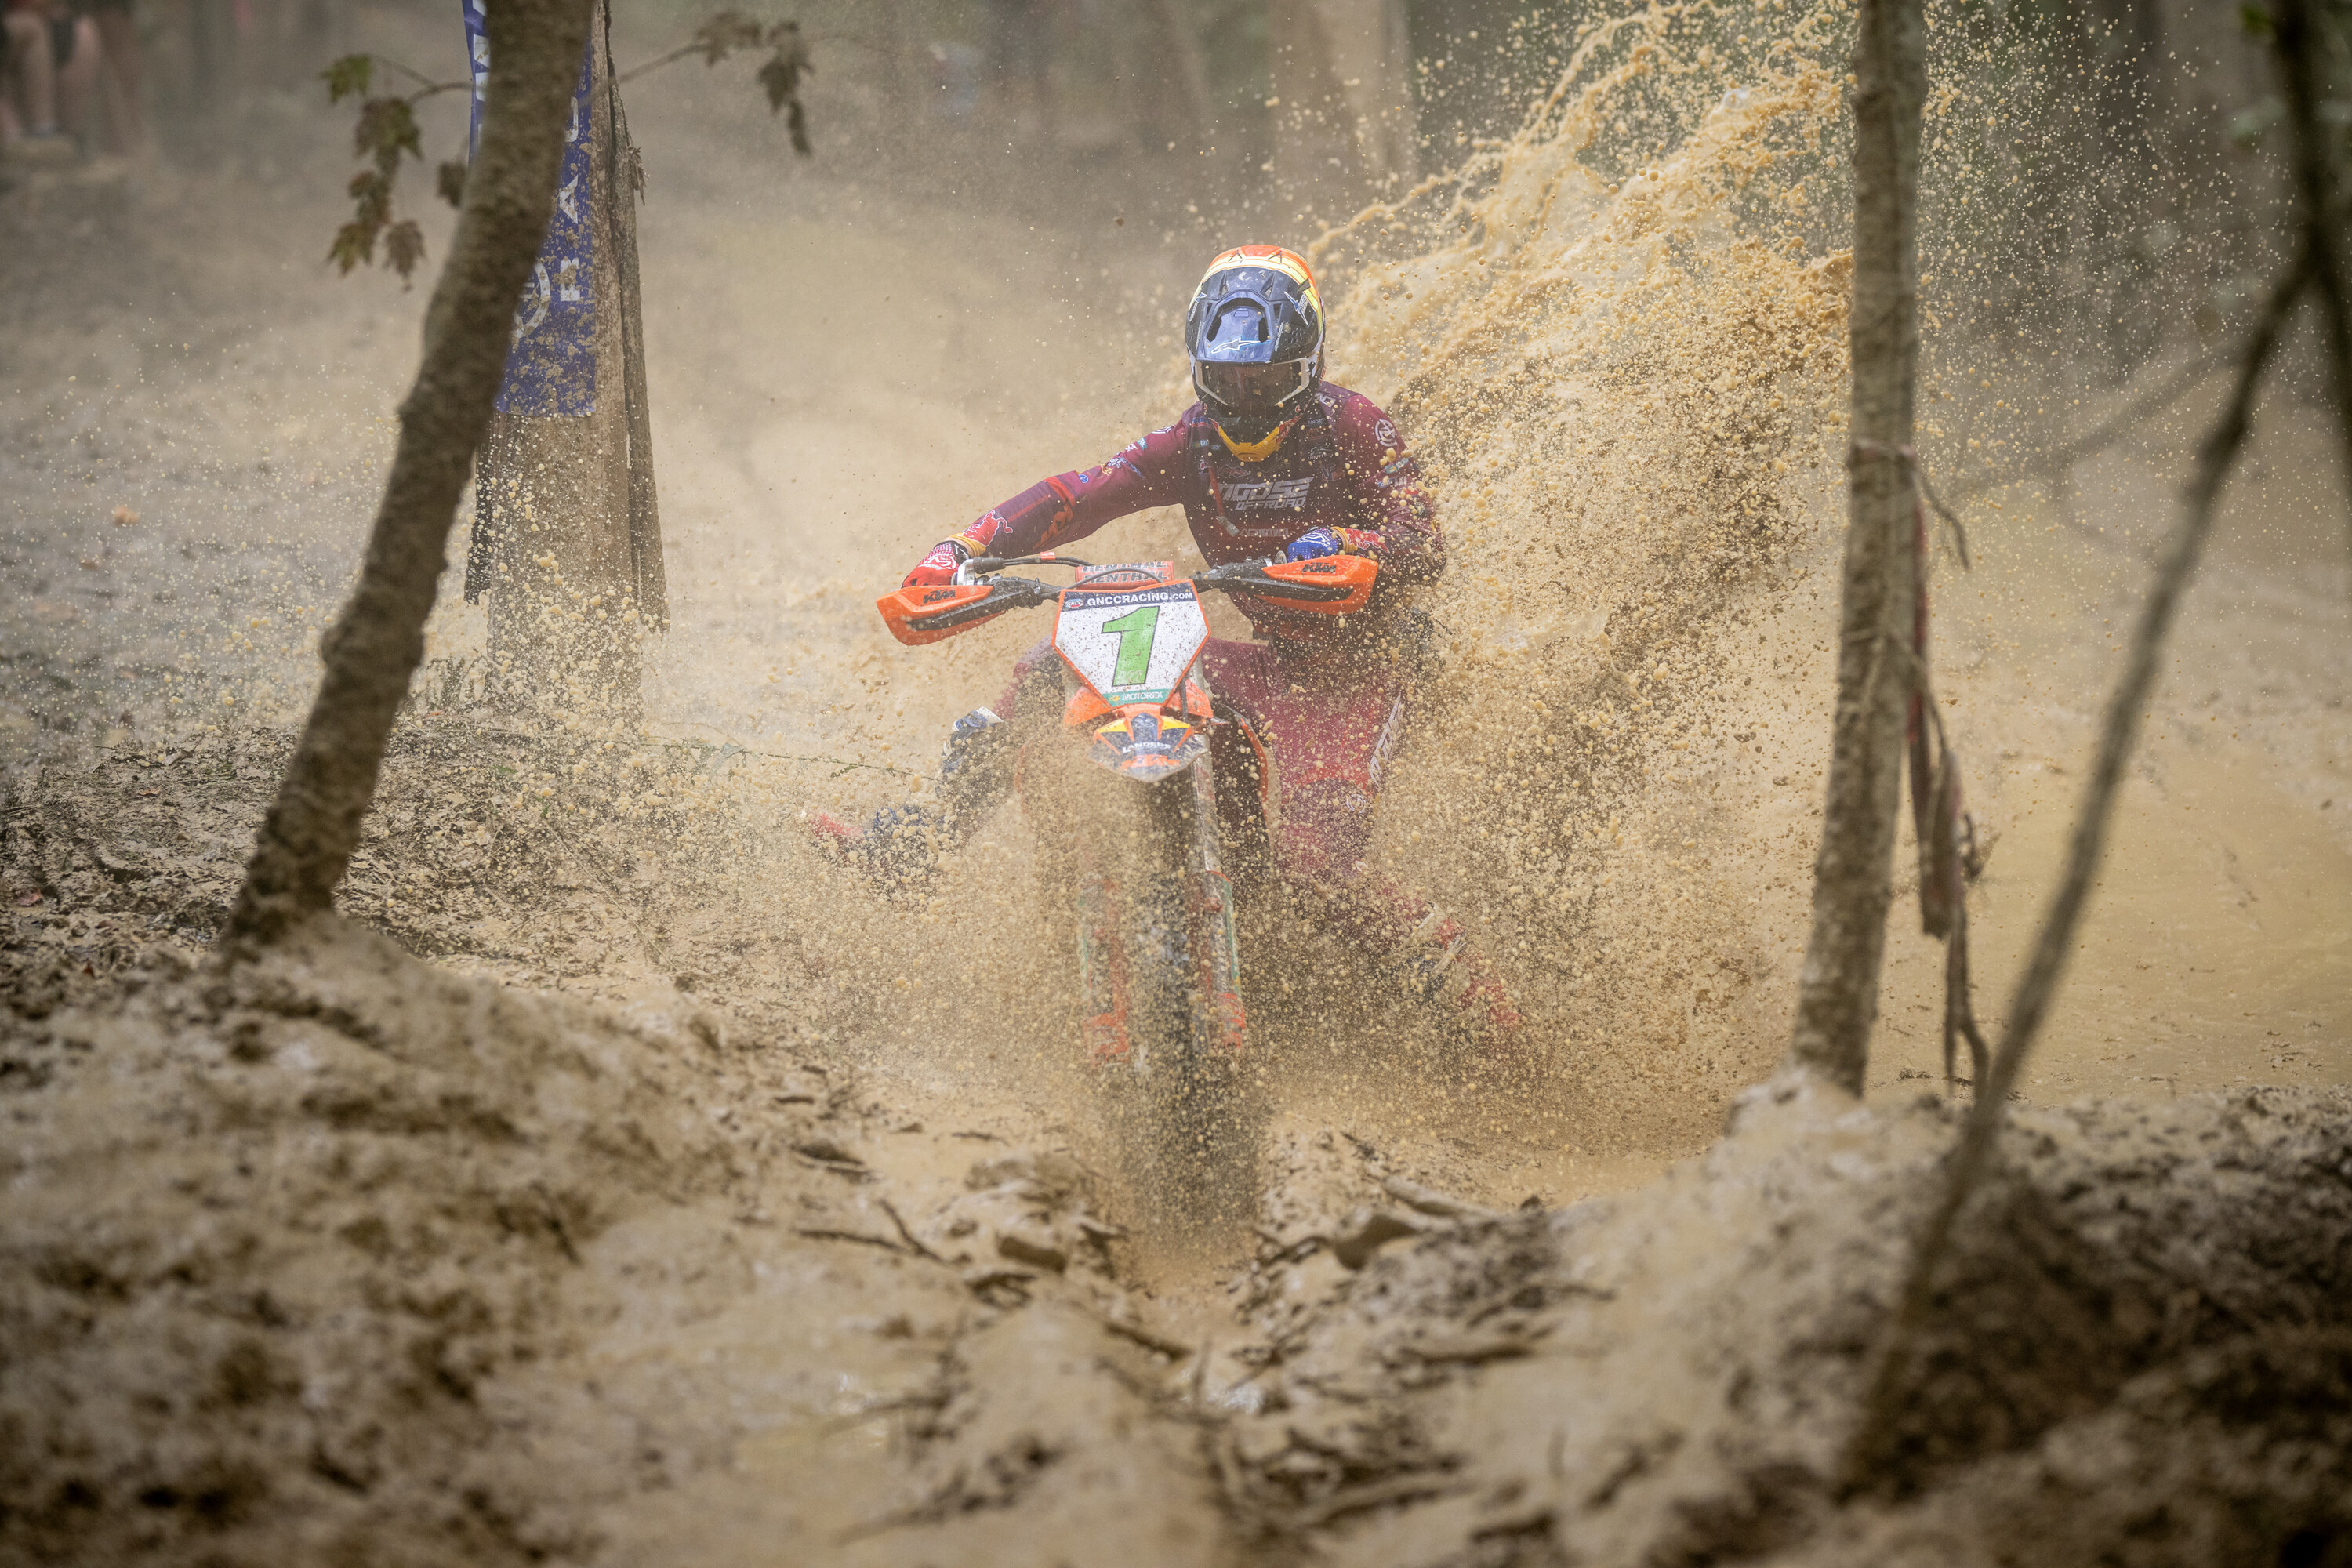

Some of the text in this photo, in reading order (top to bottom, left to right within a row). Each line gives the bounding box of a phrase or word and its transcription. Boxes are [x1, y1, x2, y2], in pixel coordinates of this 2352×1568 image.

[1235, 496, 1306, 510] OFFROAD
[1301, 562, 1337, 573] KTM
[923, 589, 956, 604] KTM
[1087, 592, 1193, 606] GNCCRACING.COM
[1101, 605, 1160, 687] 1
[1122, 691, 1164, 701] MOTOREX
